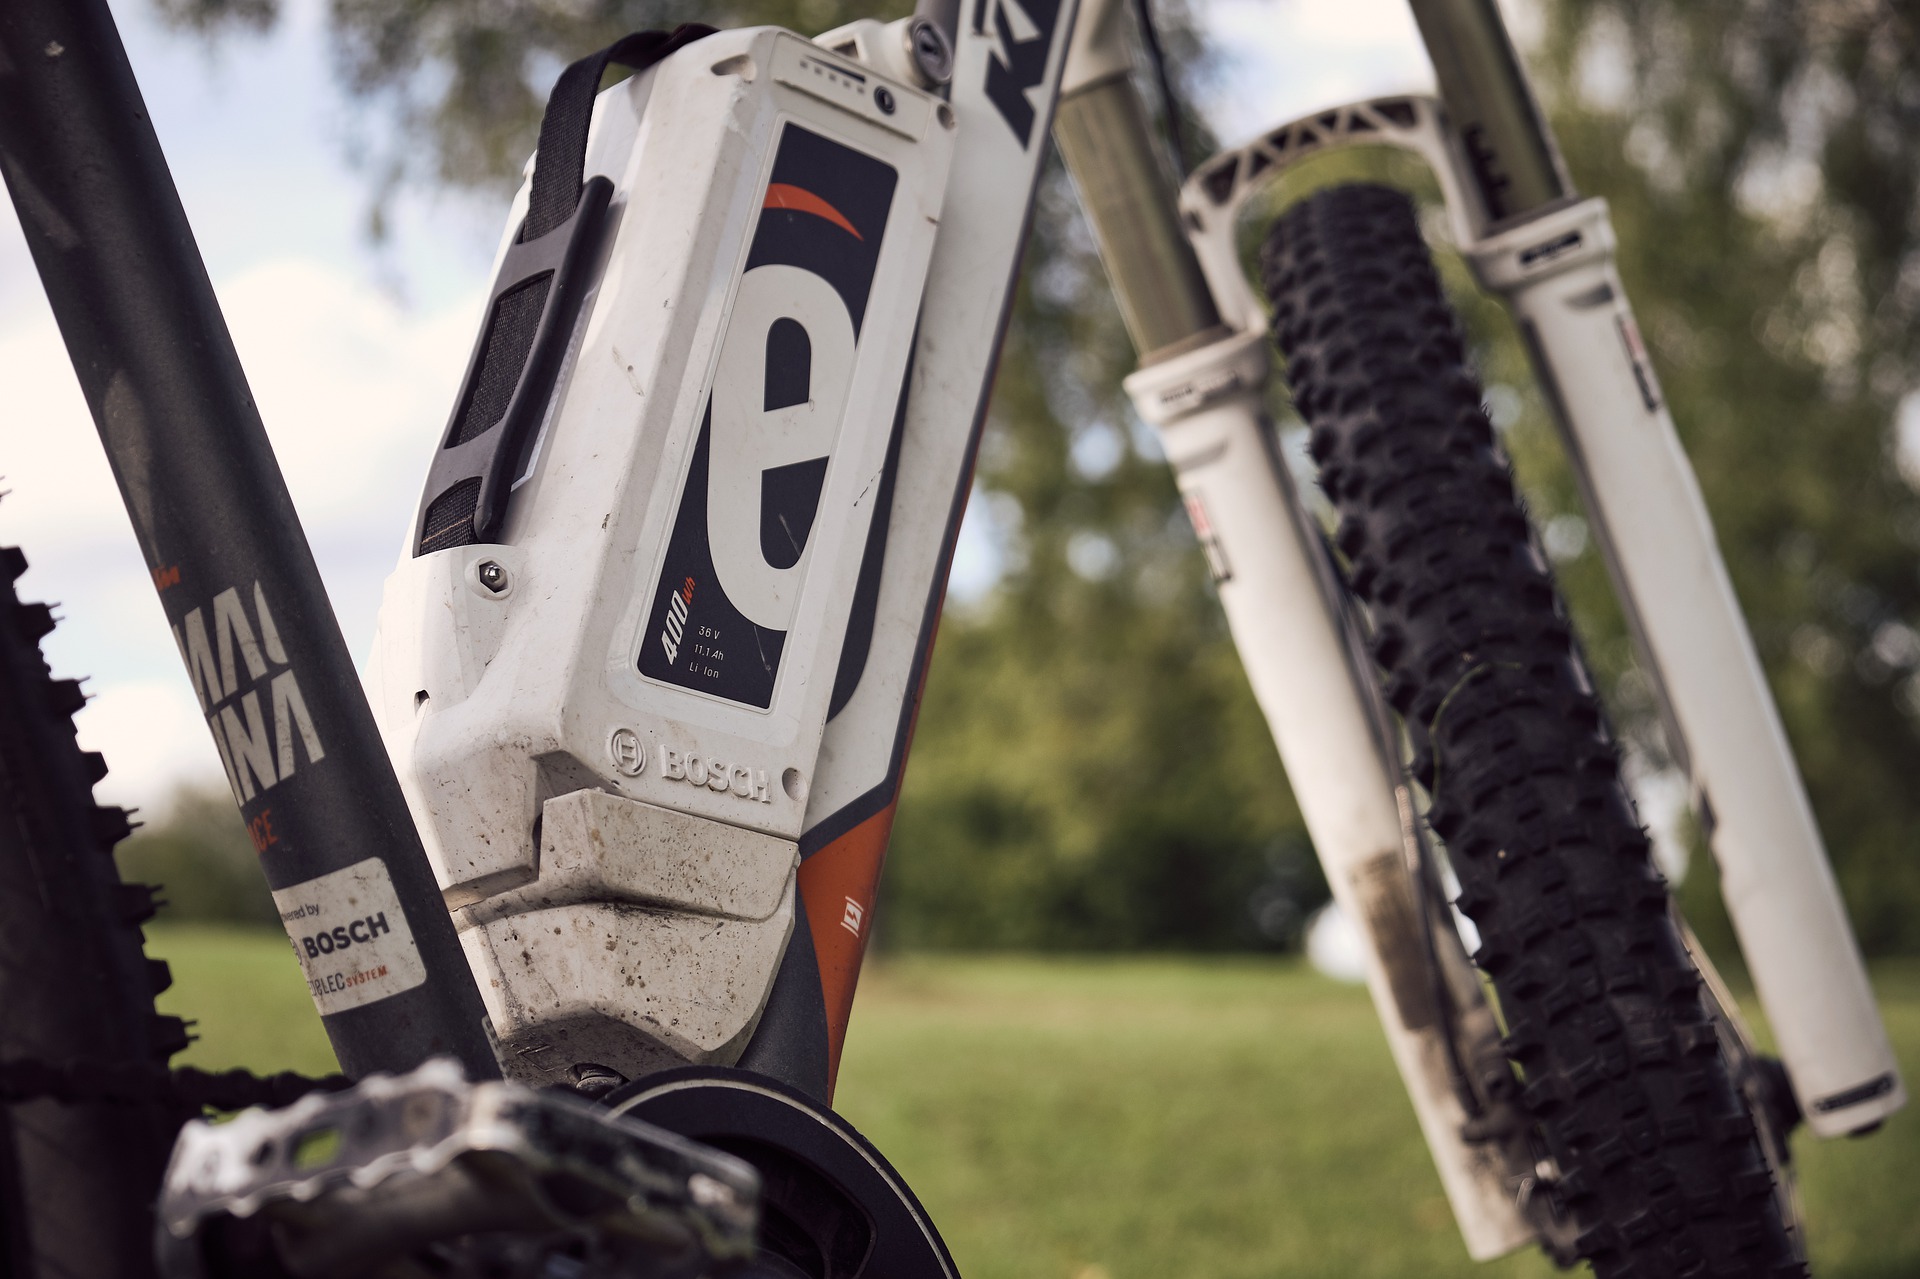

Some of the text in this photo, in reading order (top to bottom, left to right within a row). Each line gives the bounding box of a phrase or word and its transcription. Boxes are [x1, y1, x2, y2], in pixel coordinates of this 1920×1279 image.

[698, 625, 721, 640] 36 V
[694, 644, 724, 661] 11.1 Ah
[689, 661, 699, 673] Li
[659, 744, 772, 805] BOSCH
[305, 903, 320, 918] by
[302, 912, 391, 960] BOSCH
